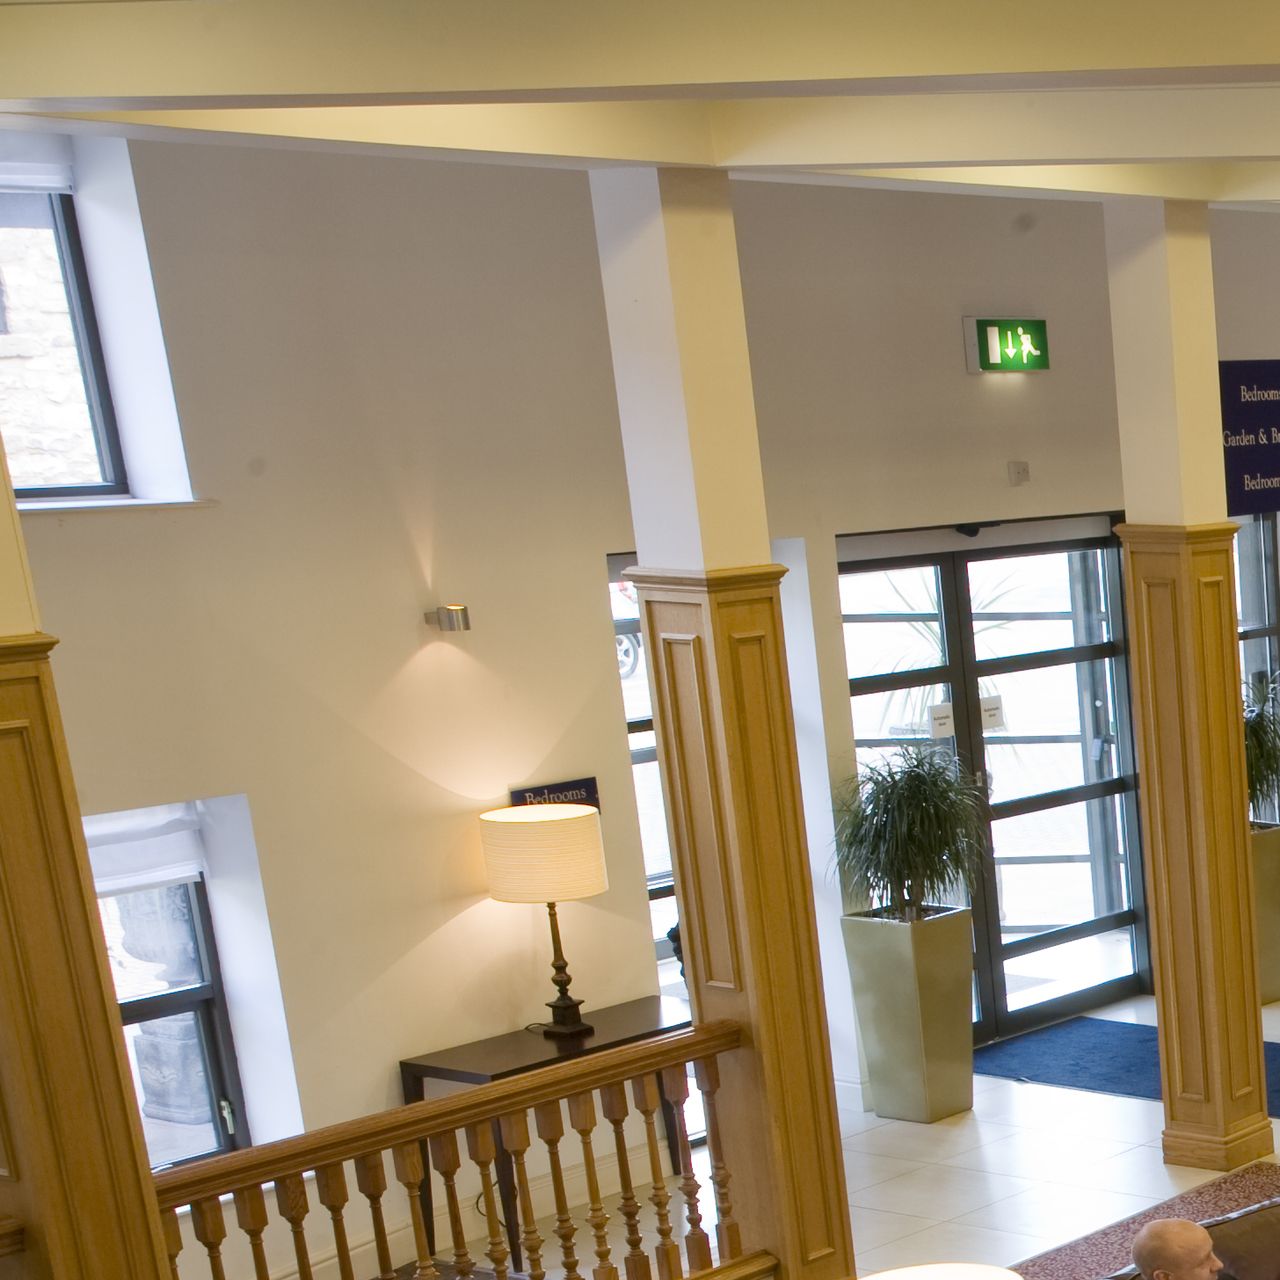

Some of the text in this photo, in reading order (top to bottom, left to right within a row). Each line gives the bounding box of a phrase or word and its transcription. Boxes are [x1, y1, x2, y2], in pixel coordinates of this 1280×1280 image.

[1223, 429, 1256, 447] Garden
[1258, 428, 1268, 445] &
[525, 788, 587, 805] Bedrooms
